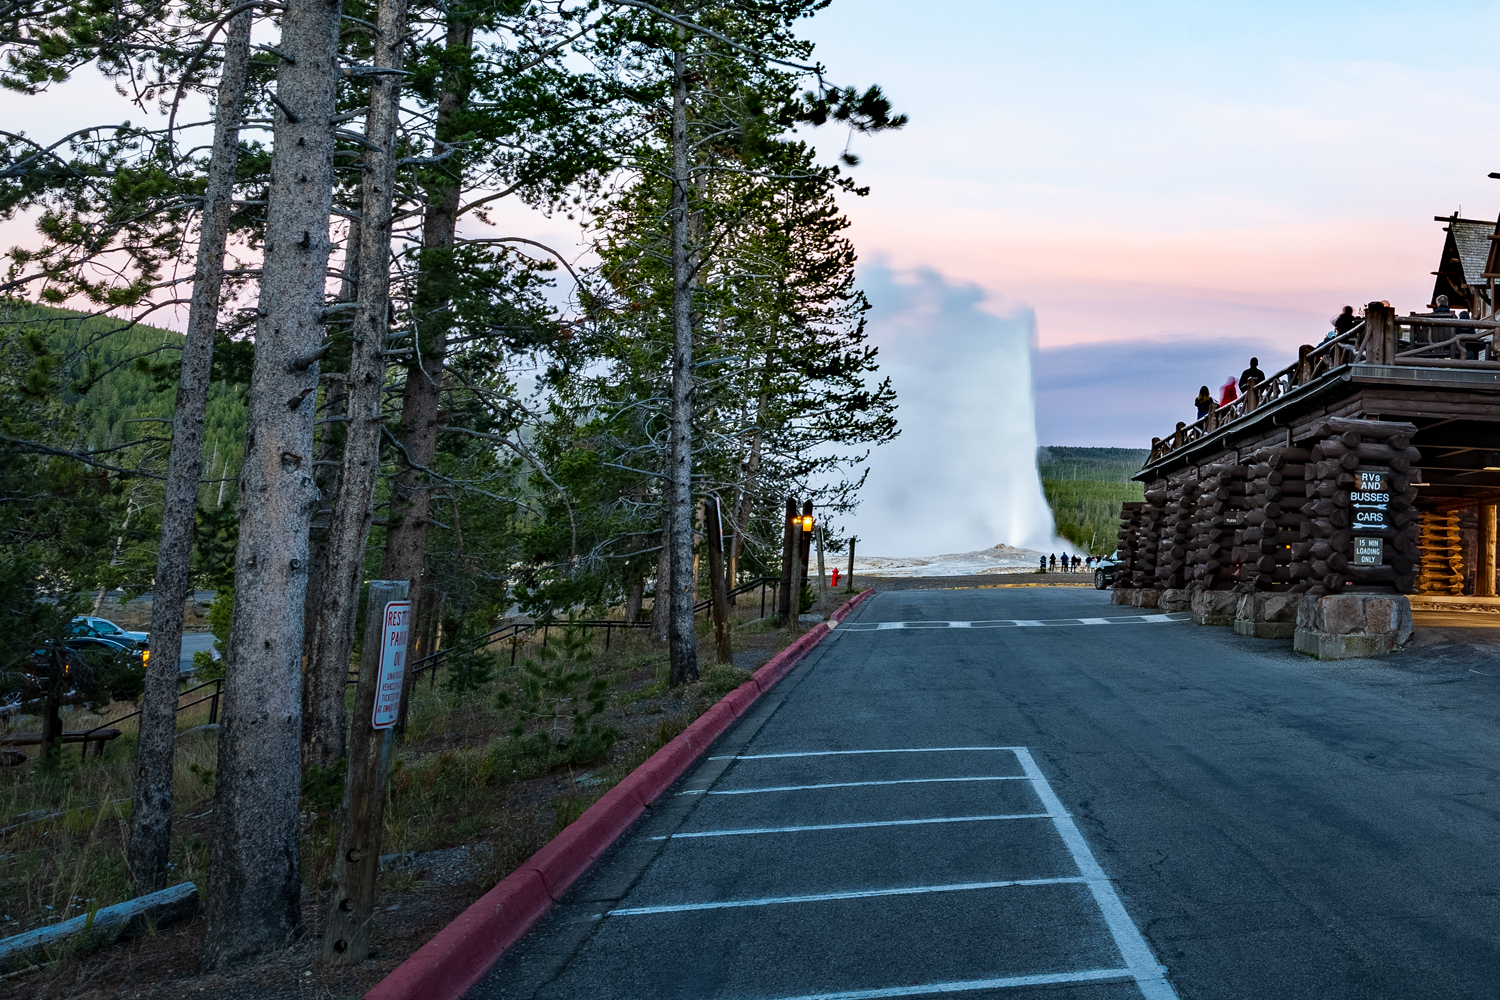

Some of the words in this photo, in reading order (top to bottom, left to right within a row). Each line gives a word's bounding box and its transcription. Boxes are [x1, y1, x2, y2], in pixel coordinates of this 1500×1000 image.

[1361, 482, 1381, 490] AND
[1350, 493, 1389, 502] BUSSES
[1357, 513, 1383, 521] CARS
[1356, 547, 1381, 555] LOADING
